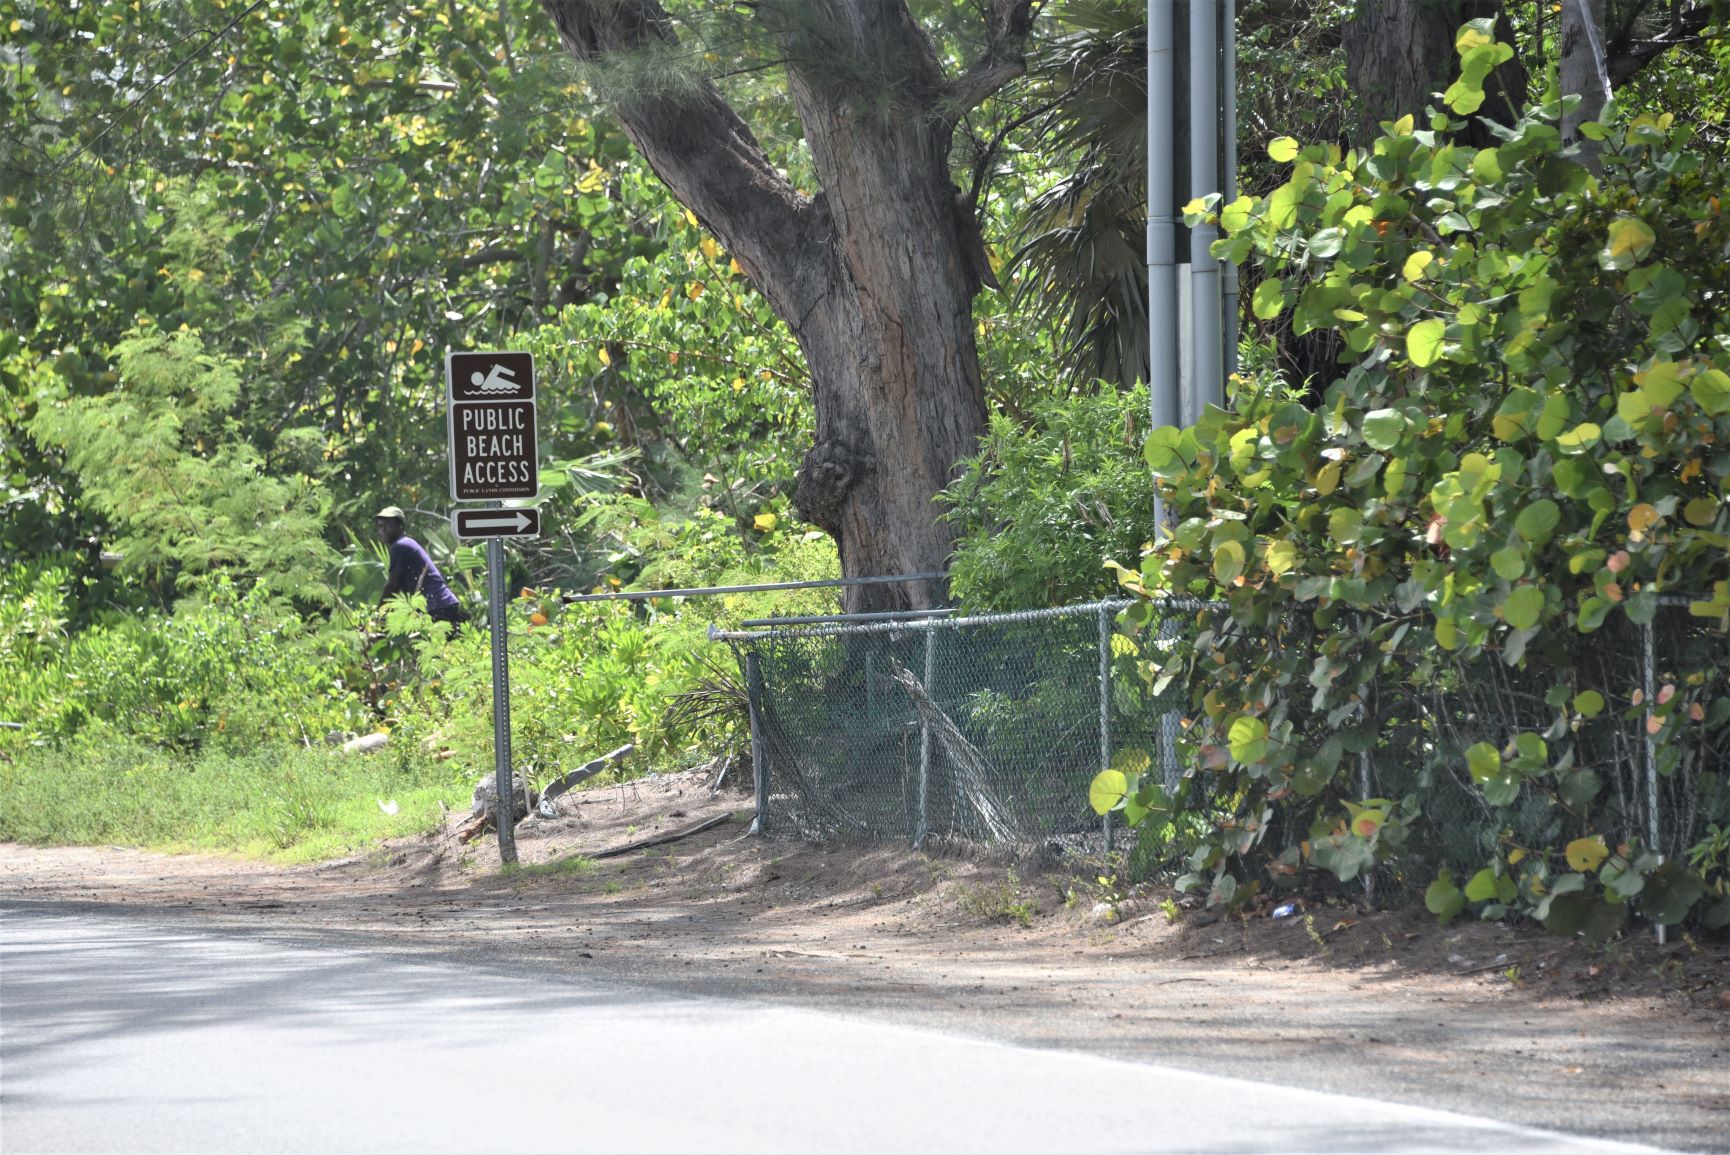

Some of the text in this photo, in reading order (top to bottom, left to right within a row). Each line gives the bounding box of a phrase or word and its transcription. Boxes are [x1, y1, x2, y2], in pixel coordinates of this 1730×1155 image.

[463, 408, 525, 431] PUBLIC
[467, 435, 523, 457] BEACH
[463, 461, 529, 484] ACCESS
